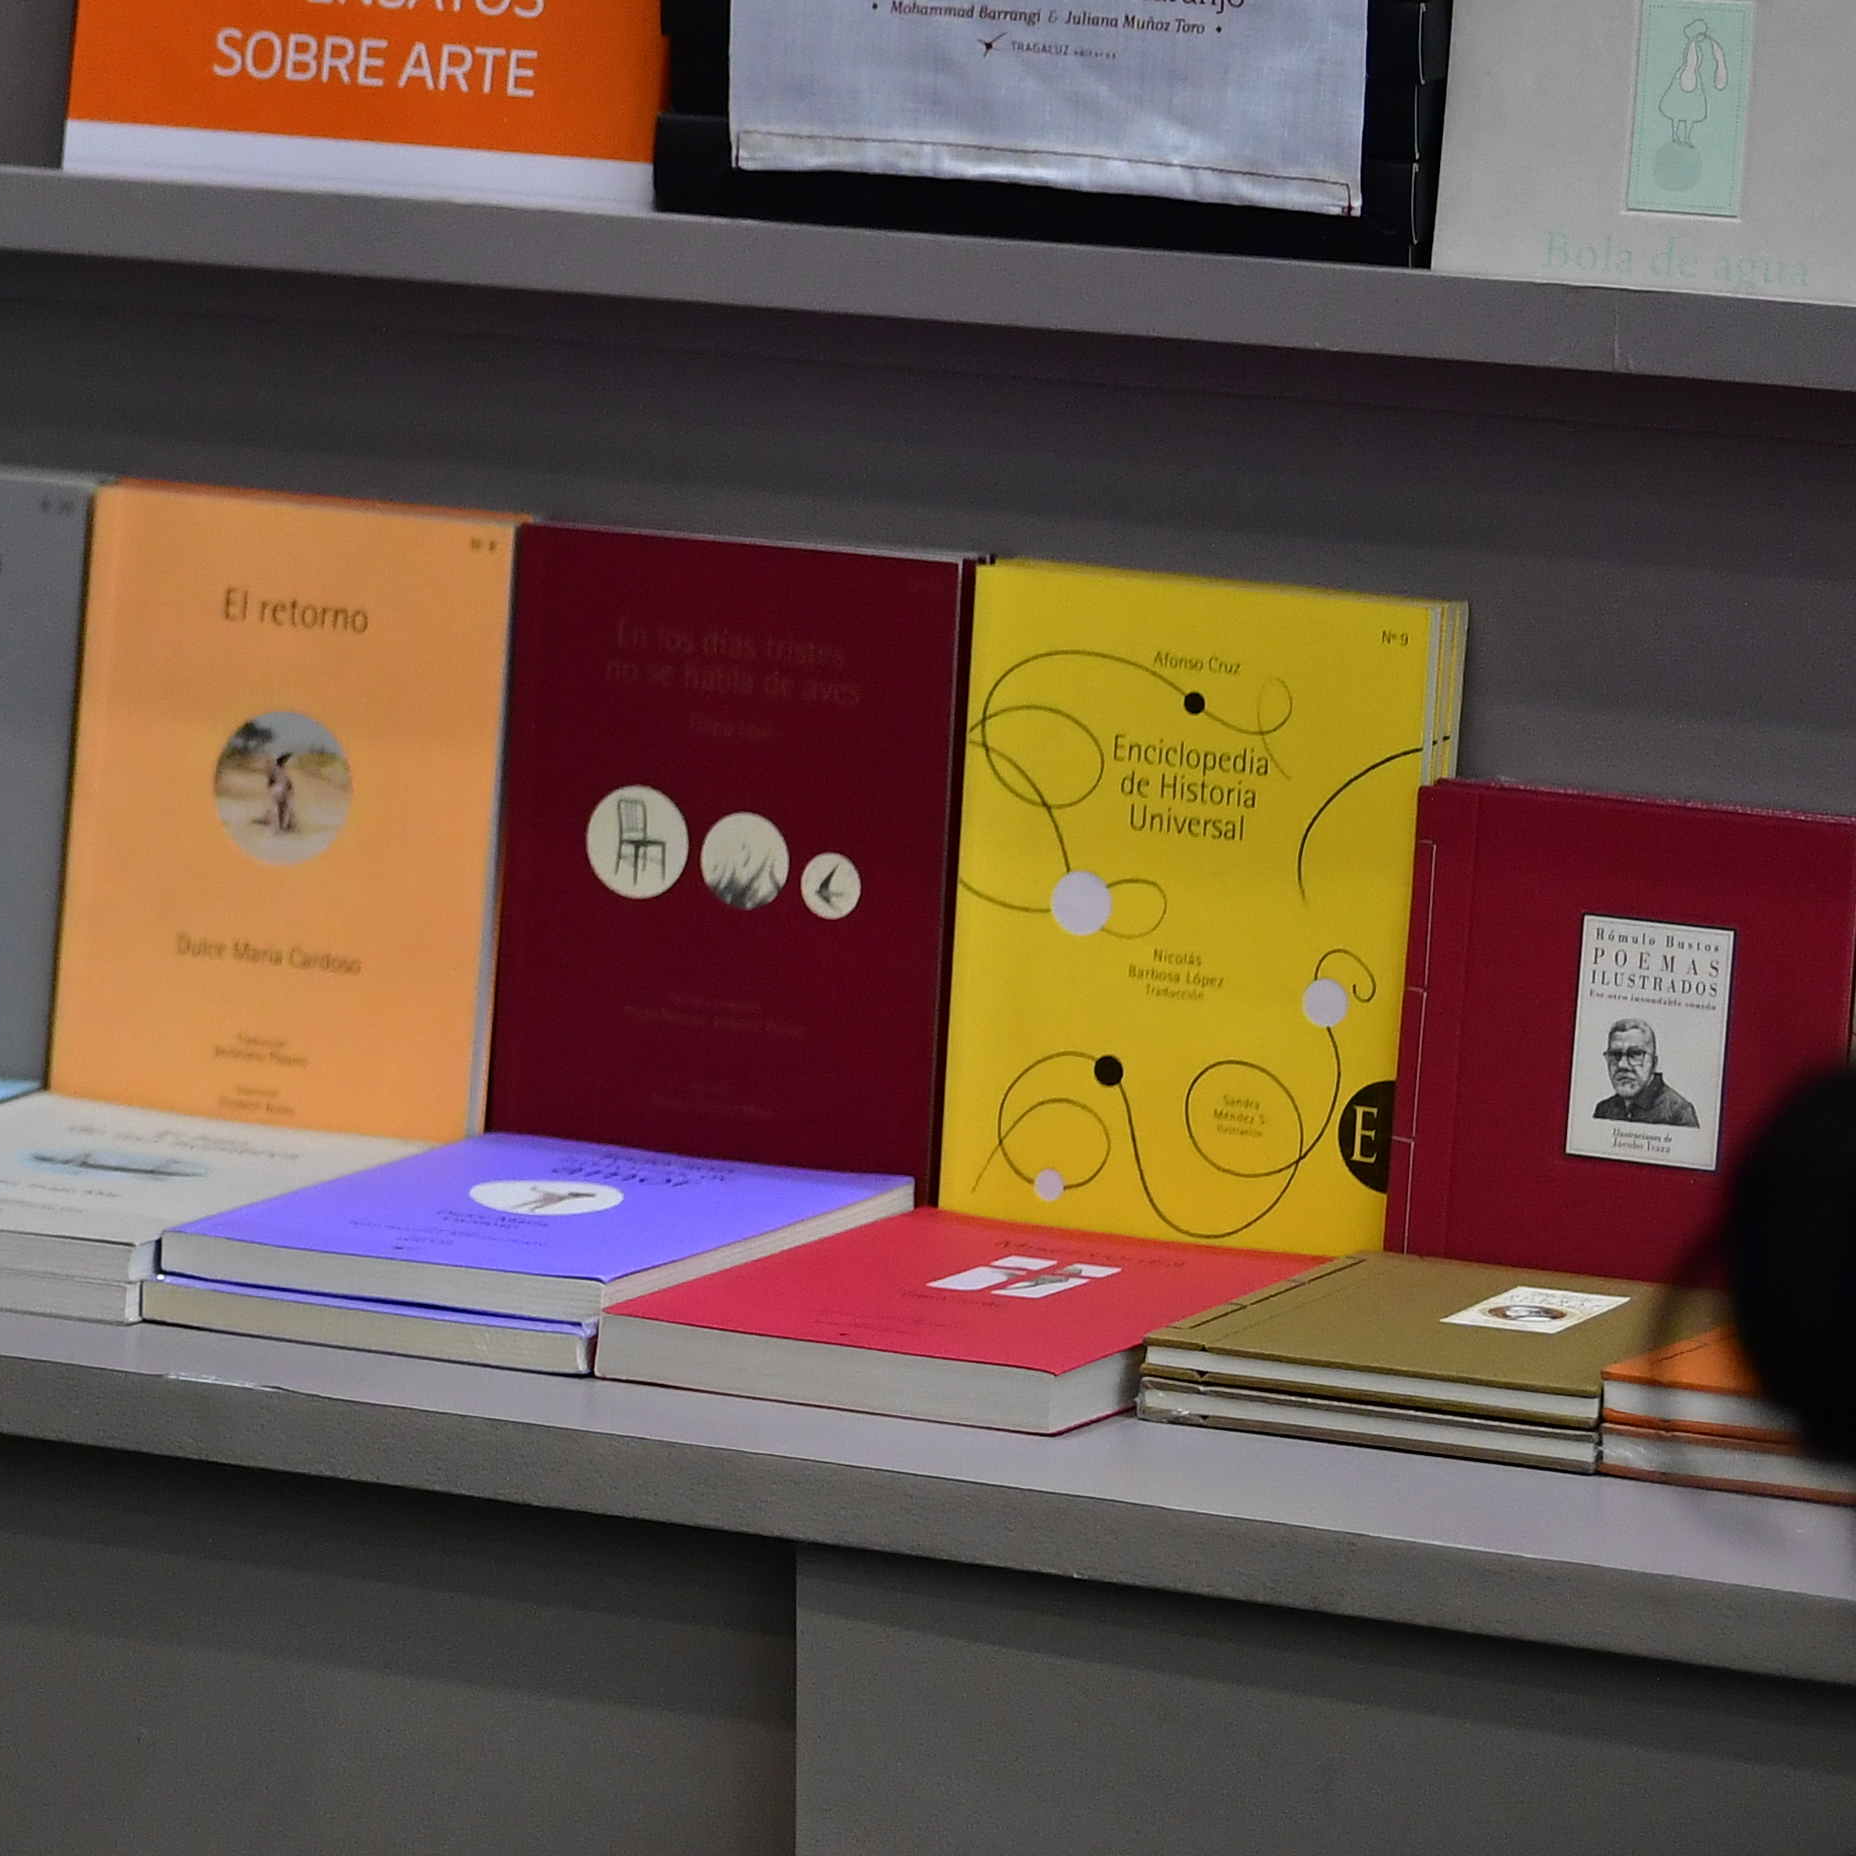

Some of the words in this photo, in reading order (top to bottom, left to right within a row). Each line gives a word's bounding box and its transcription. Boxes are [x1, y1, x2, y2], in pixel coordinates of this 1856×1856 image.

[212, 27, 389, 89] SOBRE
[398, 42, 539, 99] ARTE
[1544, 230, 1636, 276] Bola
[1650, 236, 1702, 279] de
[1712, 256, 1811, 294] agua
[1153, 650, 1204, 672] Afonso
[1208, 655, 1242, 676] Cruz
[1113, 733, 1270, 778] Enciclopedia
[1120, 774, 1152, 799] de
[1159, 774, 1257, 810] Historia
[1129, 804, 1245, 842] Universal
[1592, 947, 1720, 979] POEMAS
[1591, 969, 1718, 997] ILUSTRADOS
[1349, 1104, 1380, 1165] E
